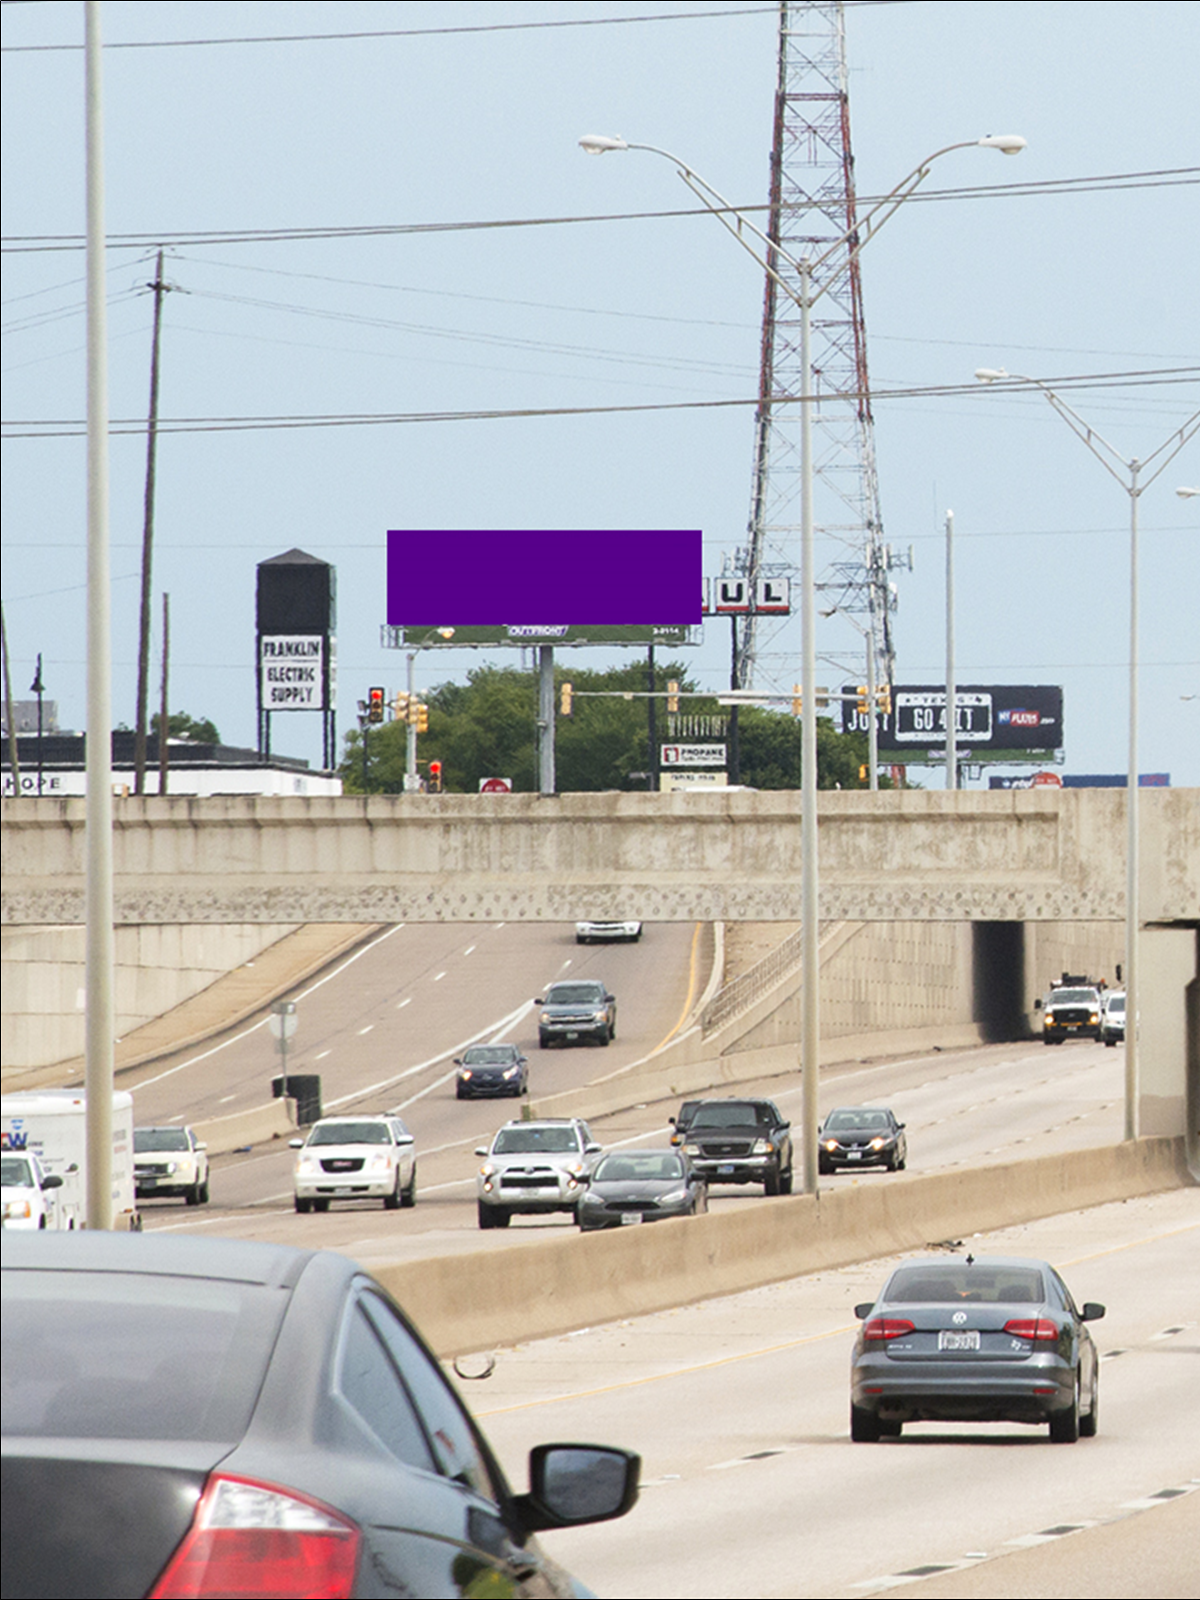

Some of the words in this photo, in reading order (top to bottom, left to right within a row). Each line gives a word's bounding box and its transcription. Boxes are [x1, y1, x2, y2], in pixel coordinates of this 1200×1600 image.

[702, 583, 782, 602] UL
[263, 641, 319, 657] FRANKLIN
[267, 667, 315, 682] ELECTRIC
[271, 687, 313, 703] SUPPLY
[922, 696, 965, 704] TEXS
[913, 708, 934, 731] GO
[681, 748, 724, 757] PROPANE
